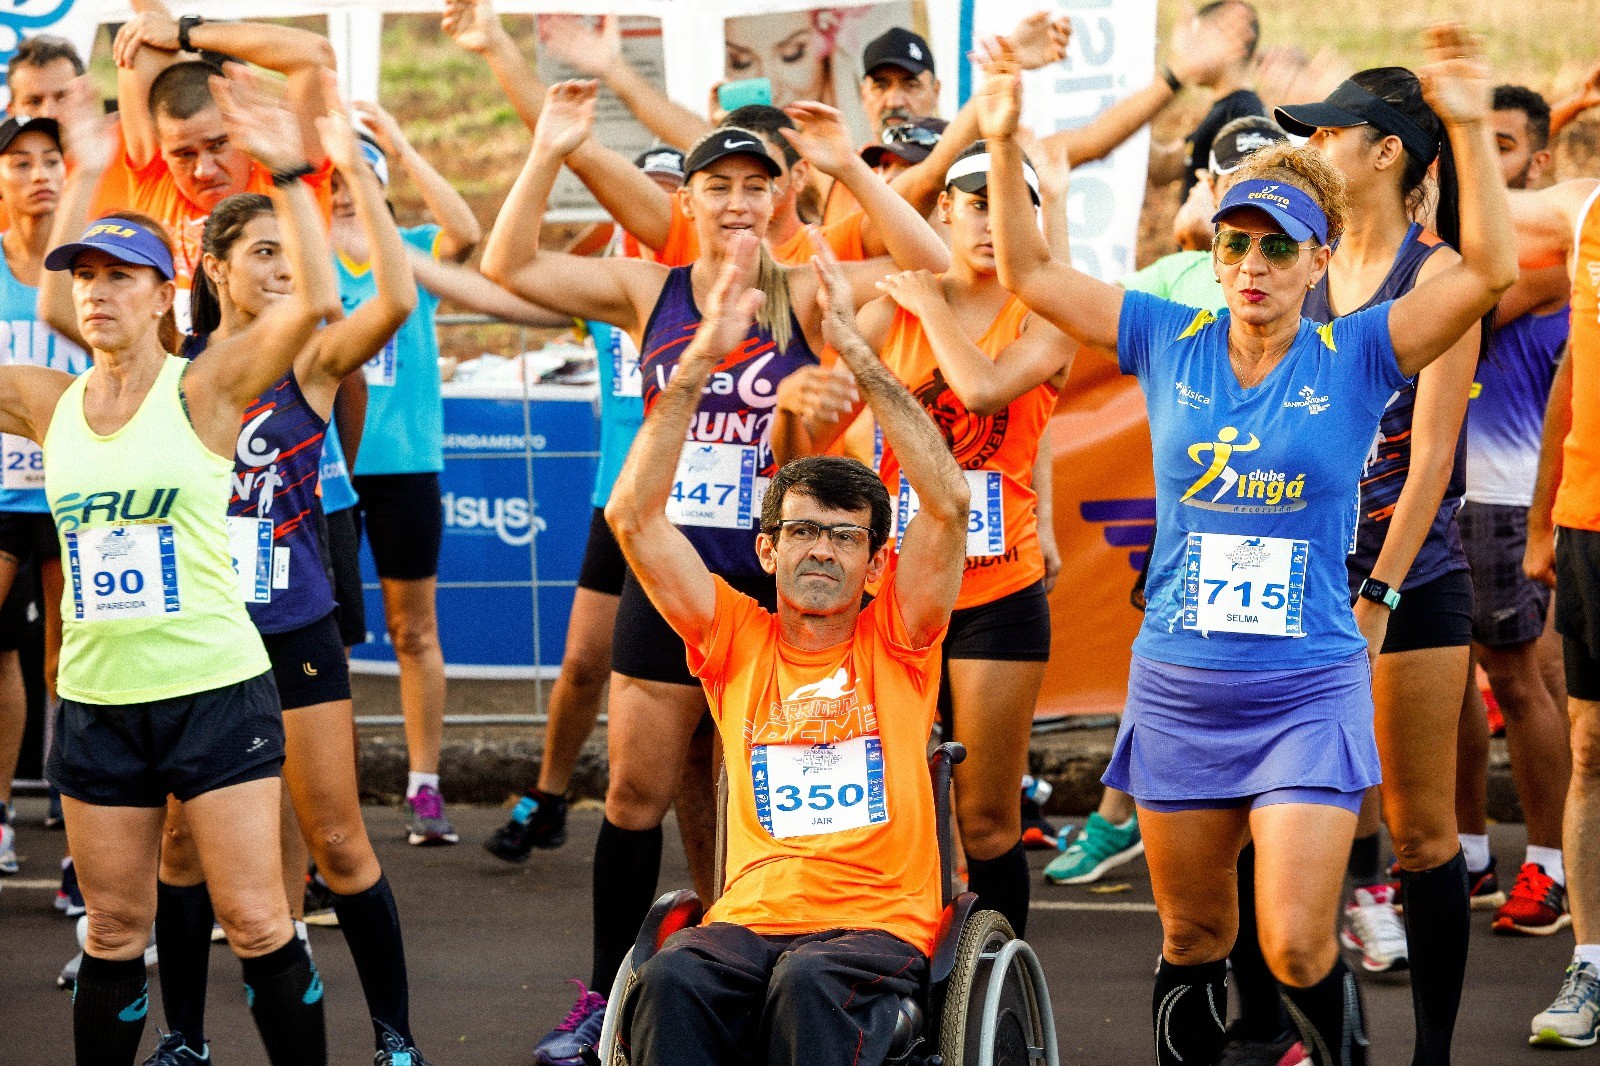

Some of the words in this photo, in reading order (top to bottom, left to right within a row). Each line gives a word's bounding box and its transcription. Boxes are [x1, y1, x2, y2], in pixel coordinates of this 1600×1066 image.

[1248, 192, 1290, 205] eucorro
[1248, 469, 1286, 482] clube
[671, 481, 736, 506] 447
[1236, 474, 1307, 505] Ingá
[681, 509, 715, 519] LUCIANE
[93, 569, 144, 596] 90
[1203, 578, 1286, 610] 715
[97, 600, 147, 611] APARECIDA
[1226, 613, 1259, 624] SELMA
[775, 783, 865, 812] 350
[811, 817, 833, 825] JAIR
